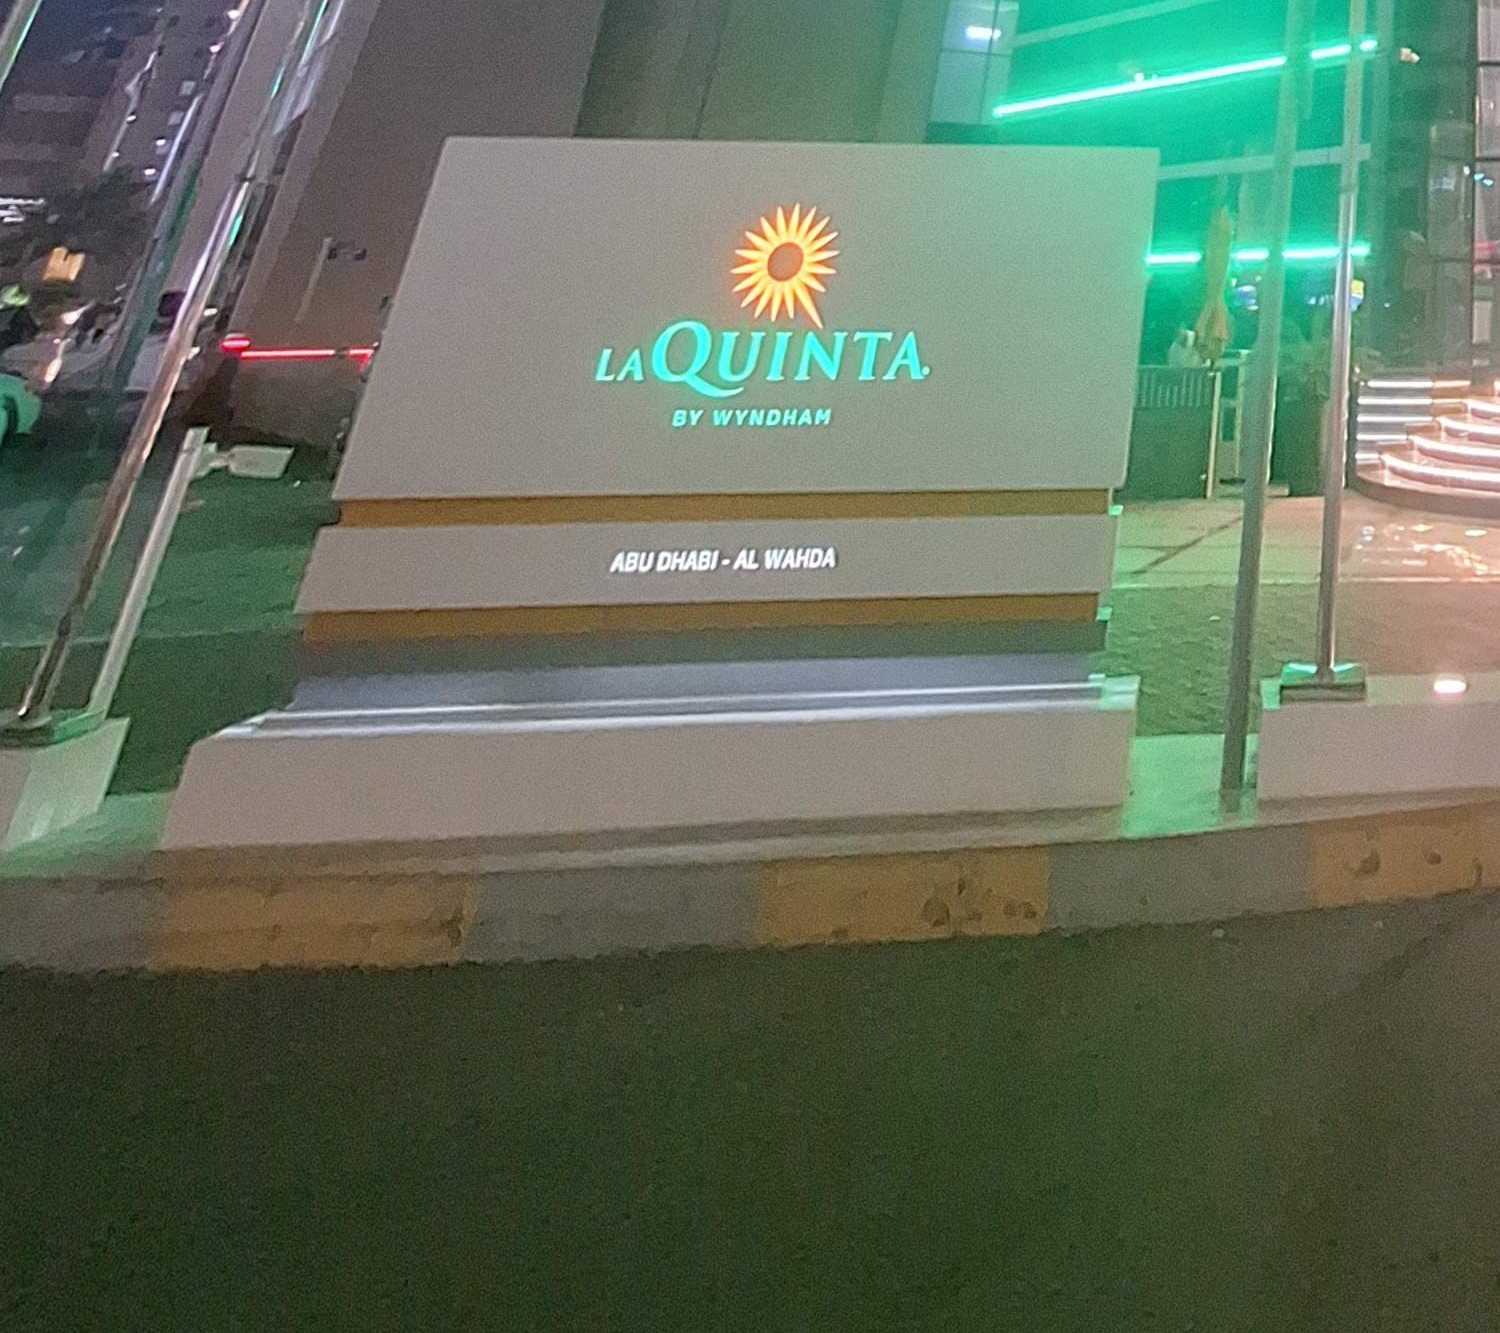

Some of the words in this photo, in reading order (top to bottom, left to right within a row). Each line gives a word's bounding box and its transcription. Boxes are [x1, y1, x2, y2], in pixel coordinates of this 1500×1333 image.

[595, 348, 644, 381] LA
[651, 320, 925, 398] QUINTA
[672, 410, 703, 427] BY
[712, 408, 832, 427] WYNDHAM
[609, 551, 655, 573] ABU
[655, 550, 720, 572] DHABI
[733, 549, 759, 570] AL
[763, 547, 836, 569] WAHDA
